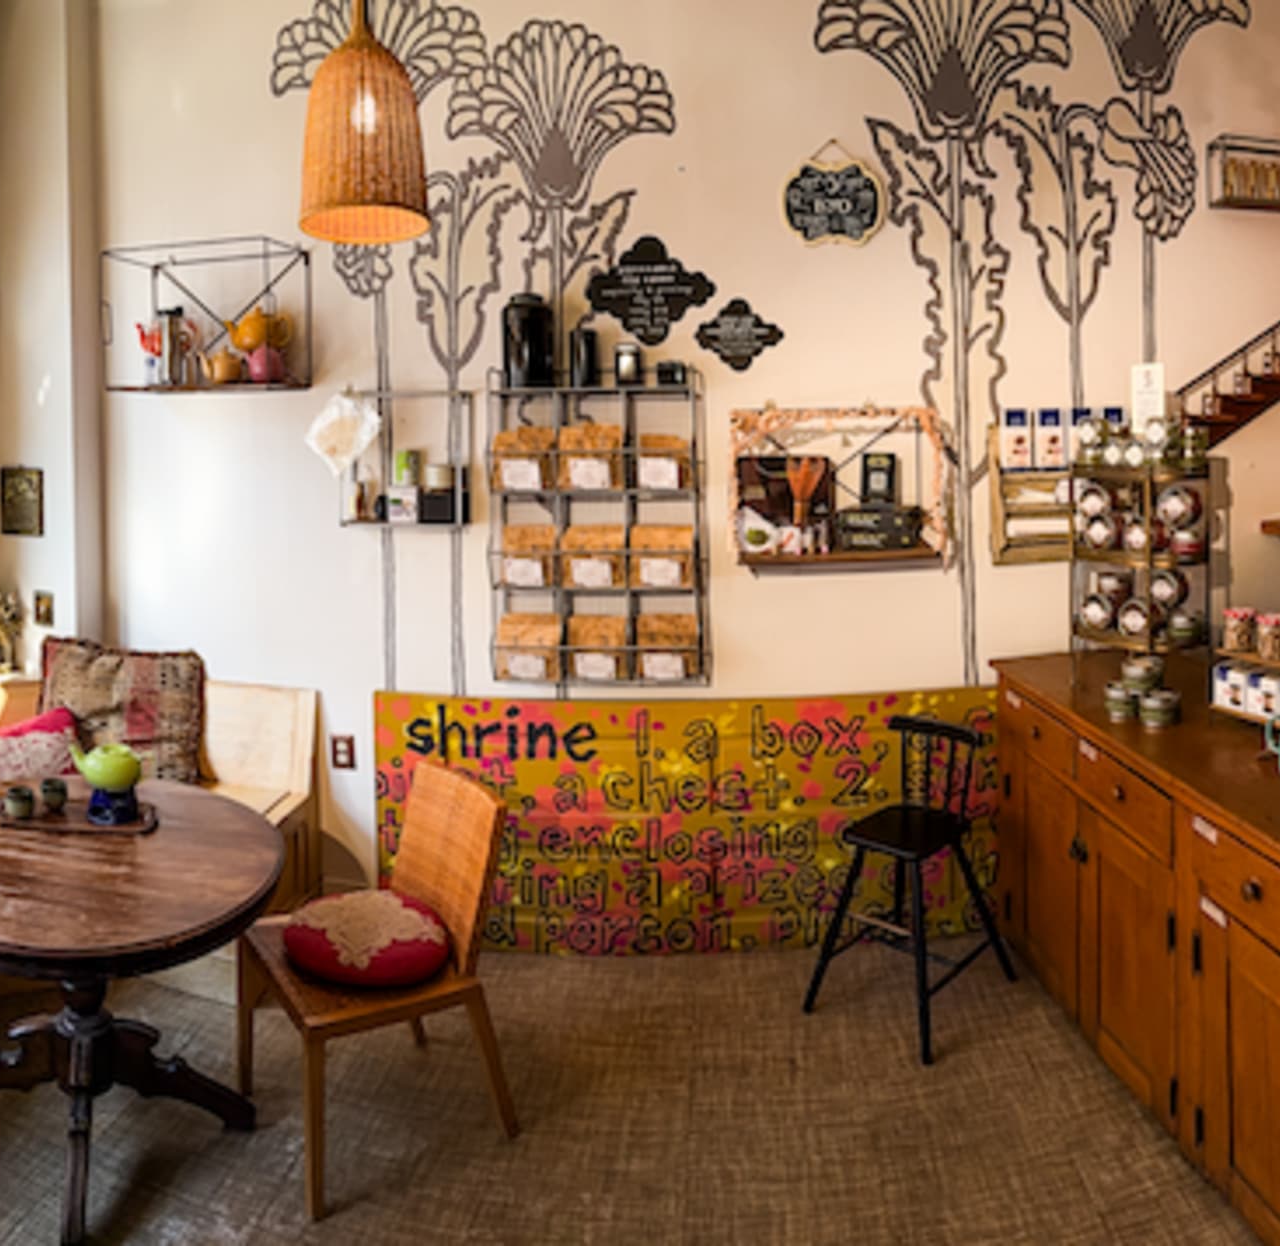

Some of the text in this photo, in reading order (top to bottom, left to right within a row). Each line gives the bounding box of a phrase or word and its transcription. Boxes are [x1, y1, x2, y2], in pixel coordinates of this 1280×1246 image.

[405, 703, 598, 763] shrine
[683, 718, 719, 765] a
[751, 704, 889, 763] box,
[552, 771, 587, 814] a
[601, 760, 806, 813] chest.
[832, 759, 890, 807] 2.
[537, 815, 818, 865] enclosing
[533, 910, 759, 955] person.
